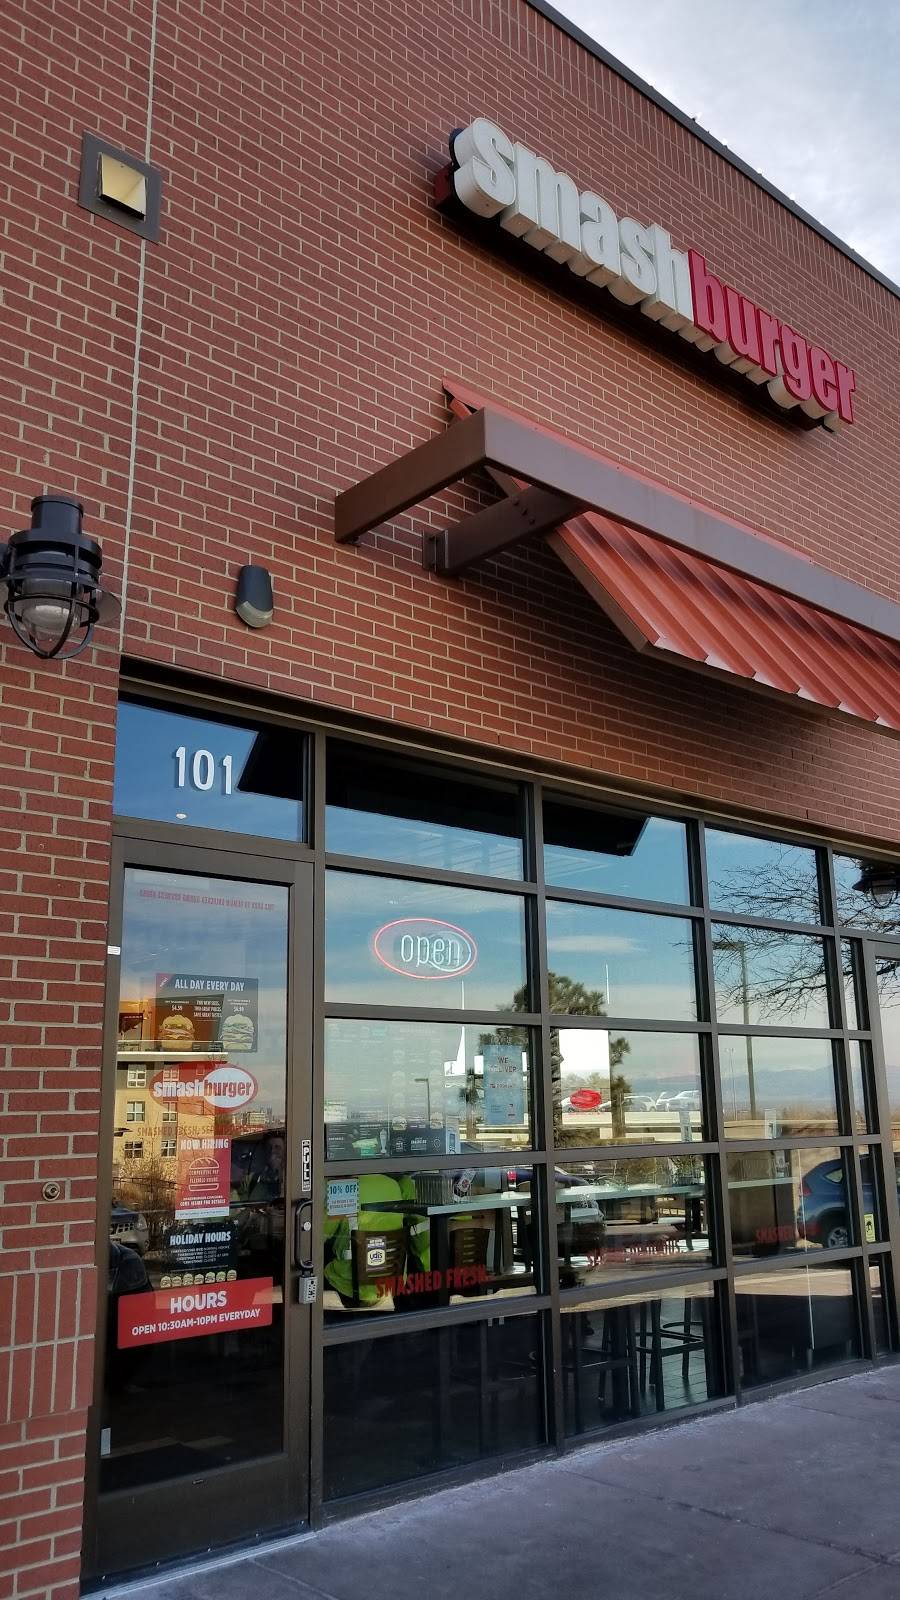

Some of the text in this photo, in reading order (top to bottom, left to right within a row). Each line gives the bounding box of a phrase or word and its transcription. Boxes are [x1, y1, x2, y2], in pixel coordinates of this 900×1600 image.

[176, 746, 233, 795] 101
[401, 935, 460, 967] open
[174, 978, 188, 990] ALL
[189, 979, 205, 990] DAY
[206, 980, 228, 991] EVERY
[230, 982, 244, 992] DAY
[153, 1077, 252, 1099] smashburger
[181, 1138, 229, 1150] NOW HIRING
[345, 1184, 357, 1194] OFF
[169, 1231, 231, 1247] HOLIDAY HOURS
[375, 1270, 442, 1297] SMASHED
[170, 1290, 227, 1314] HOURS
[132, 1308, 261, 1336] OPEN 10:30AM-10PM EVERYDAY
